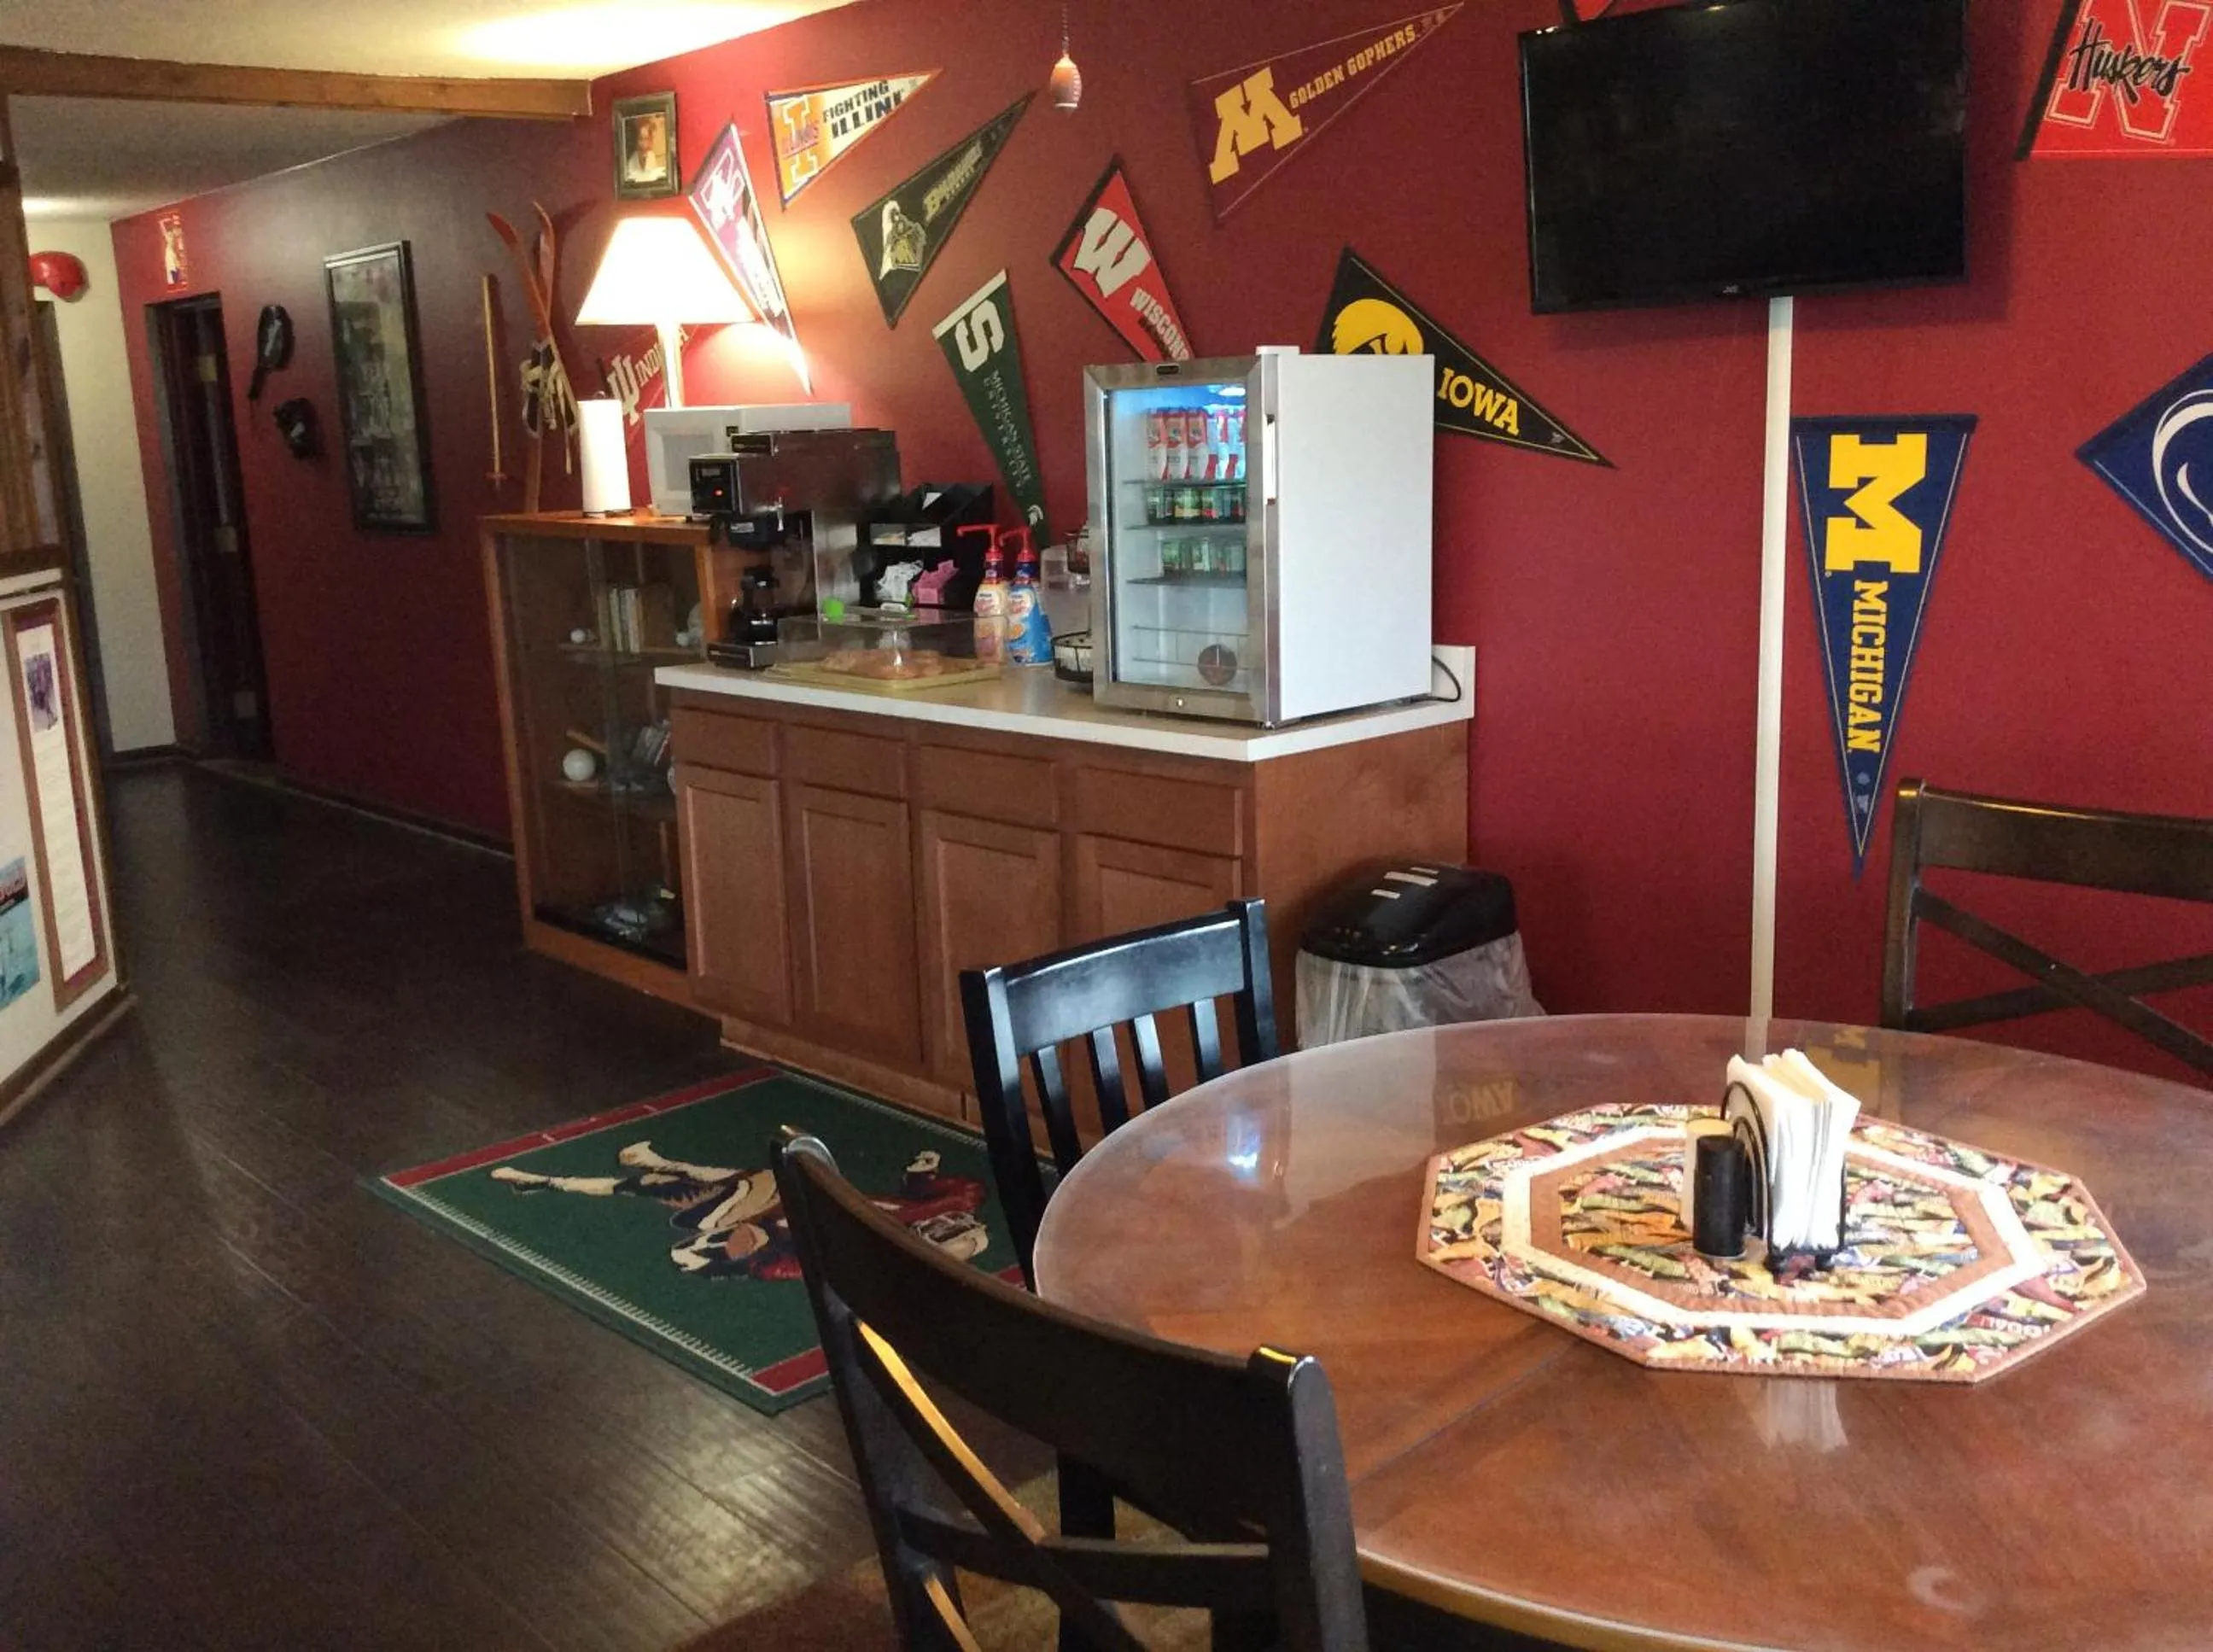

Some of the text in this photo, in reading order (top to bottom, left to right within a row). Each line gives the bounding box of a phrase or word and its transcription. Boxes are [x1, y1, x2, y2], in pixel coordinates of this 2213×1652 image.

[821, 79, 890, 124] FIGHTING
[1288, 24, 1416, 109] GOLDEN GOPHERS
[2069, 17, 2192, 104] Huskers
[1209, 66, 1303, 184] M
[1073, 207, 1152, 298] W
[955, 299, 1005, 372] S
[1436, 367, 1520, 435] IOWA
[1825, 433, 1928, 574] M
[1847, 580, 1889, 754] MICHIGAN
